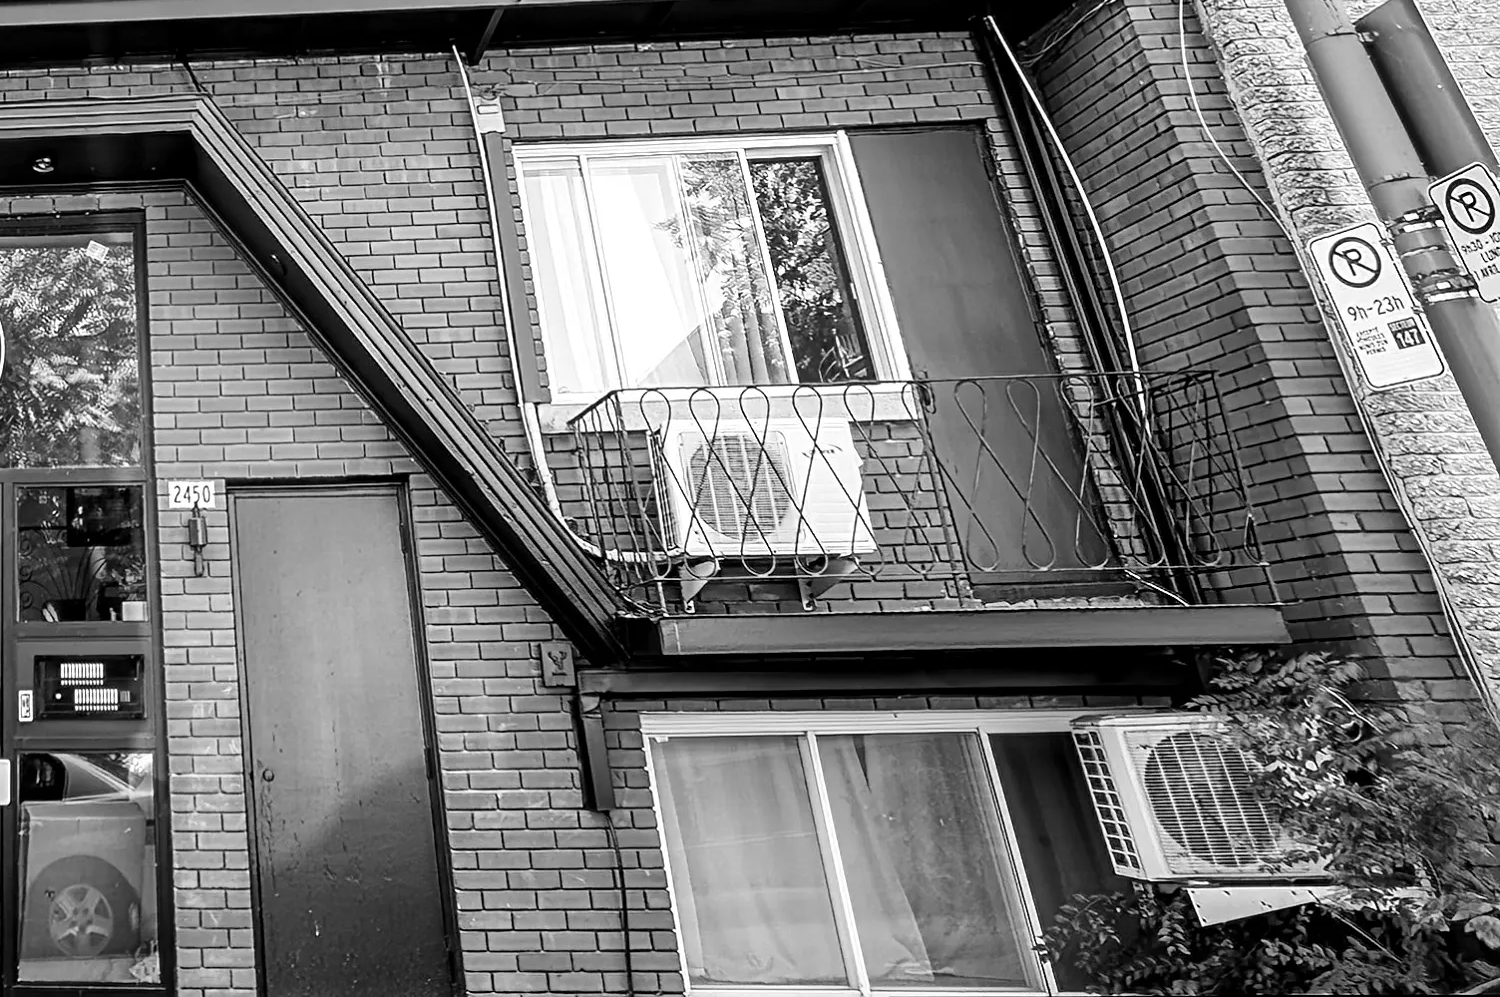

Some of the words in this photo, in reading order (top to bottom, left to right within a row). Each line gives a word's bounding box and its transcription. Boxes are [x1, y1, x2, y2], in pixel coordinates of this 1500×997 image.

[1347, 295, 1405, 321] 9h-23h
[1396, 328, 1421, 348] 147
[173, 485, 211, 503] 2450
